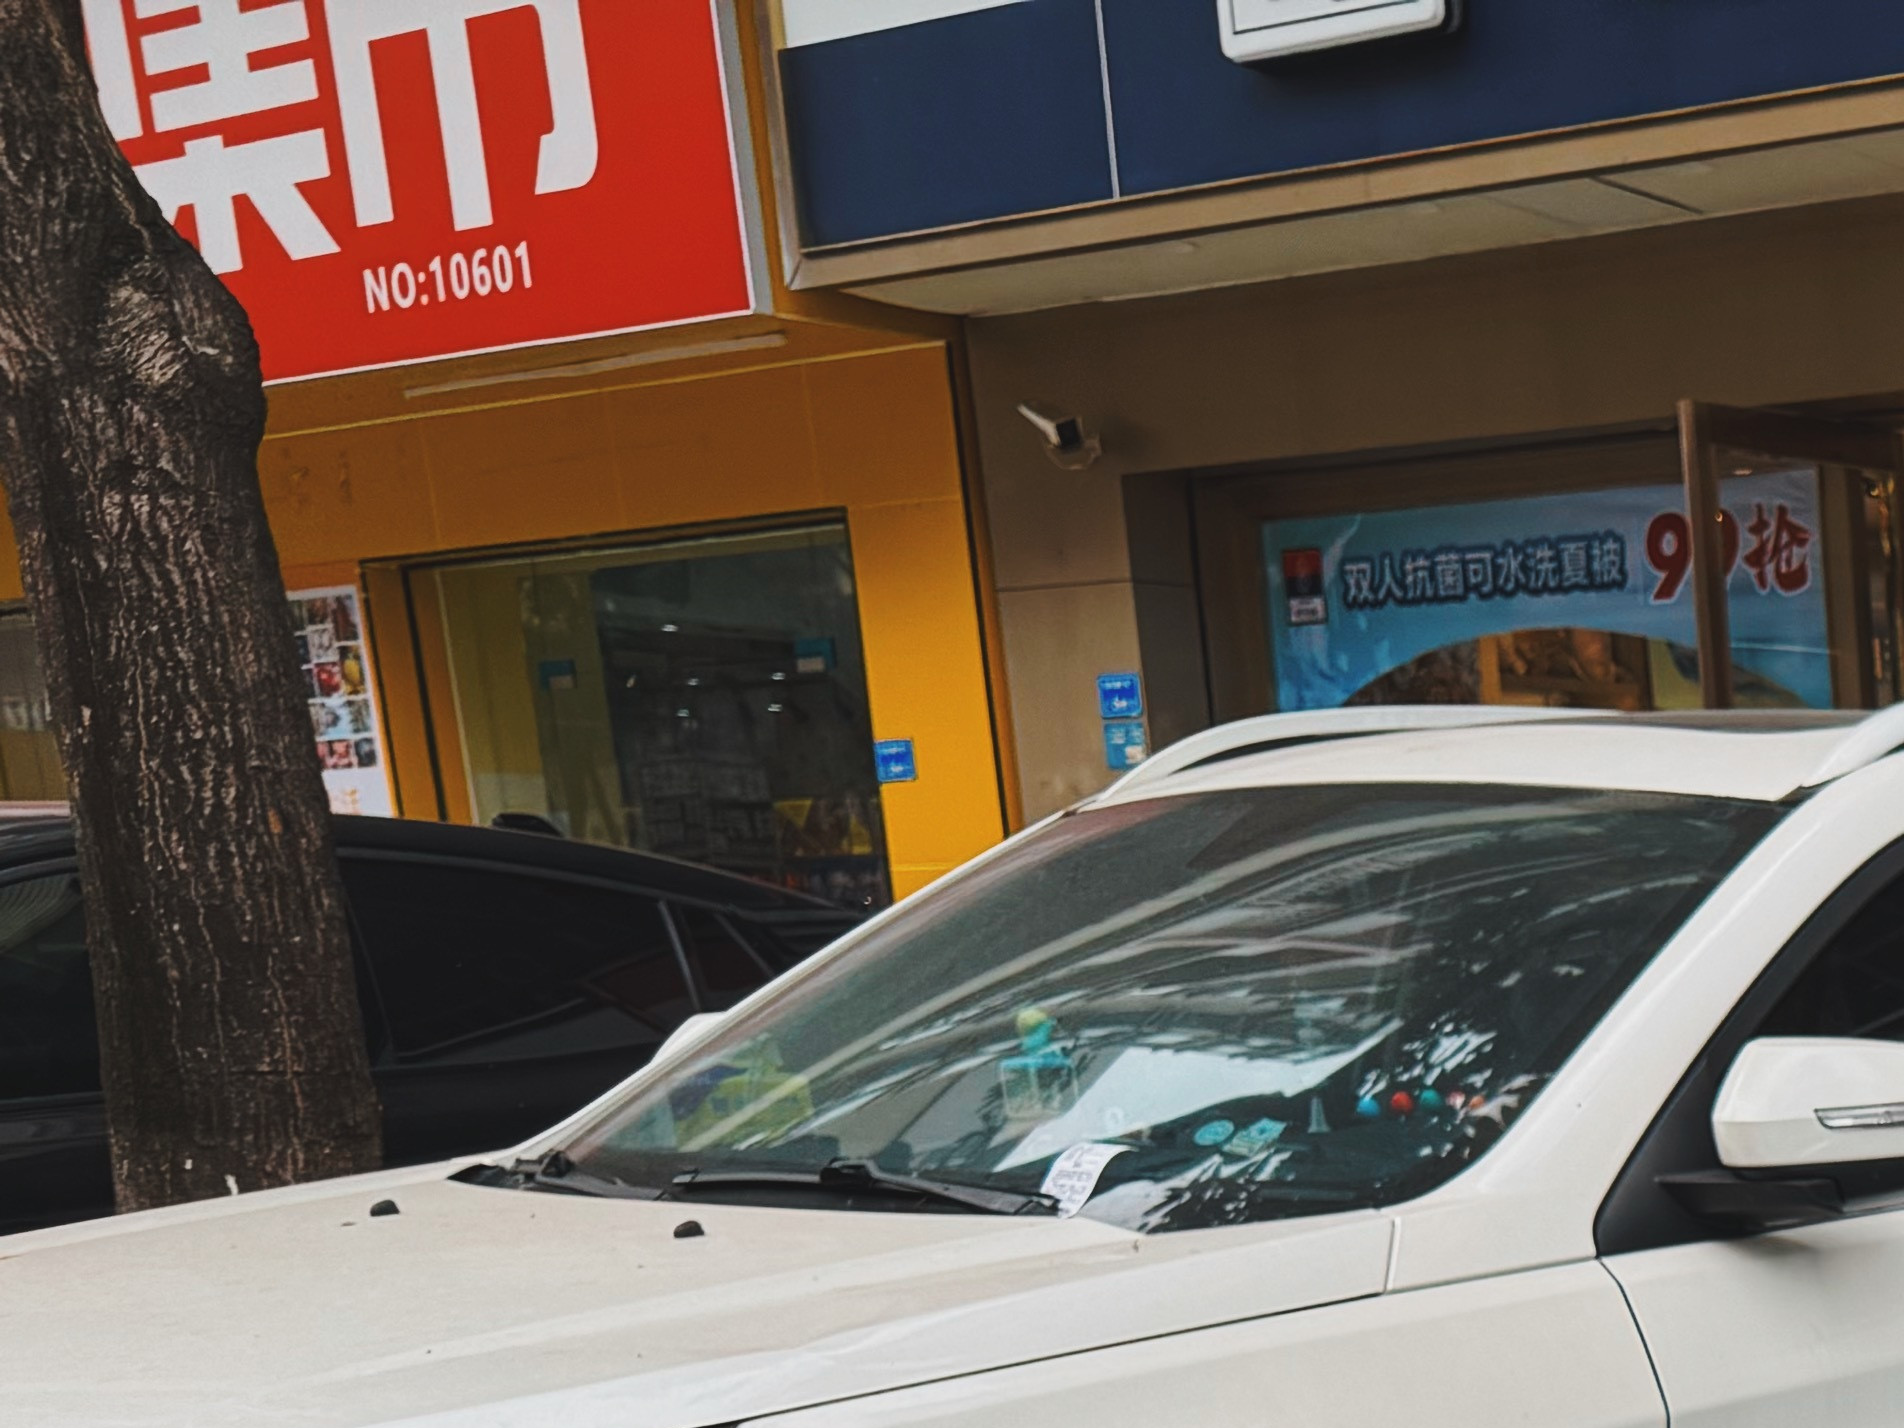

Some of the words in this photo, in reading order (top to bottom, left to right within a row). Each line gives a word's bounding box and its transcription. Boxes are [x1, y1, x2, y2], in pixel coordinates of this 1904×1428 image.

[362, 240, 534, 314] NO:10601
[1344, 540, 1625, 603] 双人抗菌可水洗夏被
